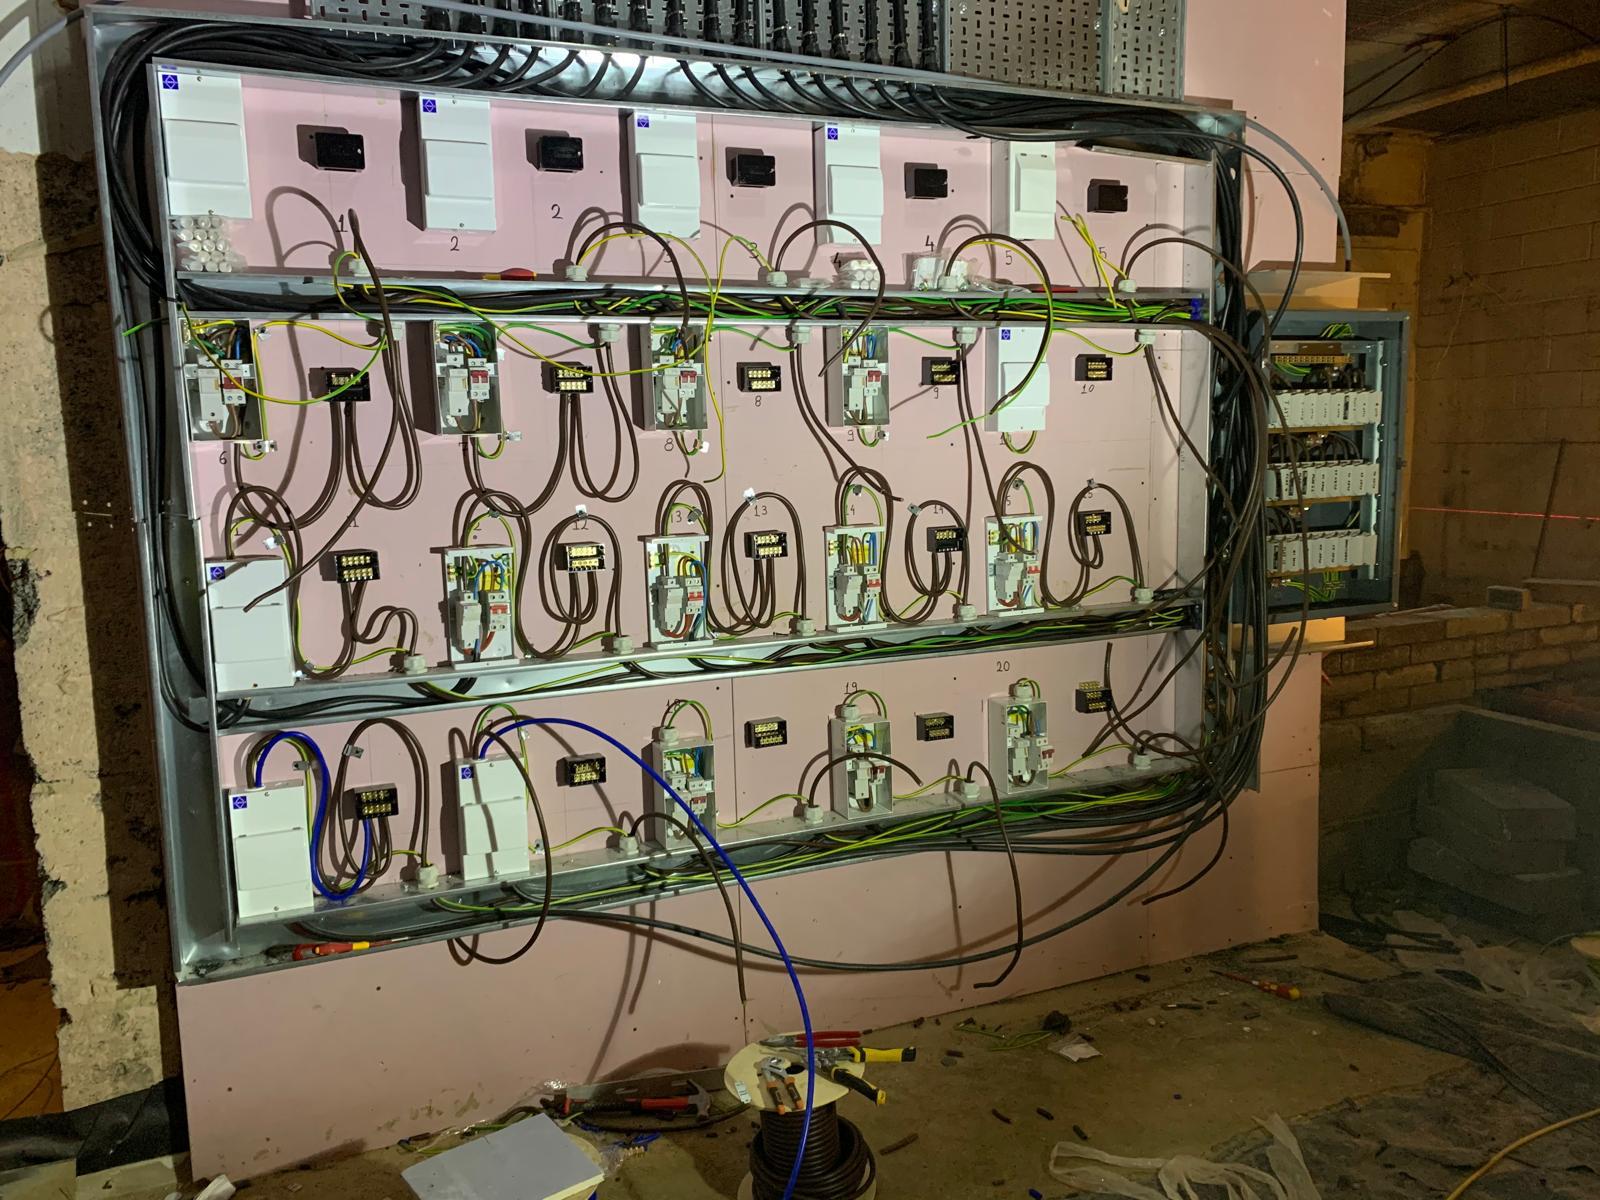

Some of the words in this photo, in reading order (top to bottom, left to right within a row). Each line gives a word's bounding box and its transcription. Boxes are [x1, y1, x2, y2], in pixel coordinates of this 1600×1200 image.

[551, 204, 564, 219] 2
[335, 214, 348, 232] 1
[450, 236, 460, 252] 2
[925, 235, 934, 252] 4
[834, 252, 841, 268] 4
[1005, 250, 1012, 265] 5
[1081, 384, 1095, 394] 10
[755, 395, 762, 407] 8
[664, 437, 674, 451] 8
[219, 451, 227, 465] 6
[754, 505, 767, 517] 13
[996, 661, 1010, 672] 20
[844, 682, 858, 694] 19
